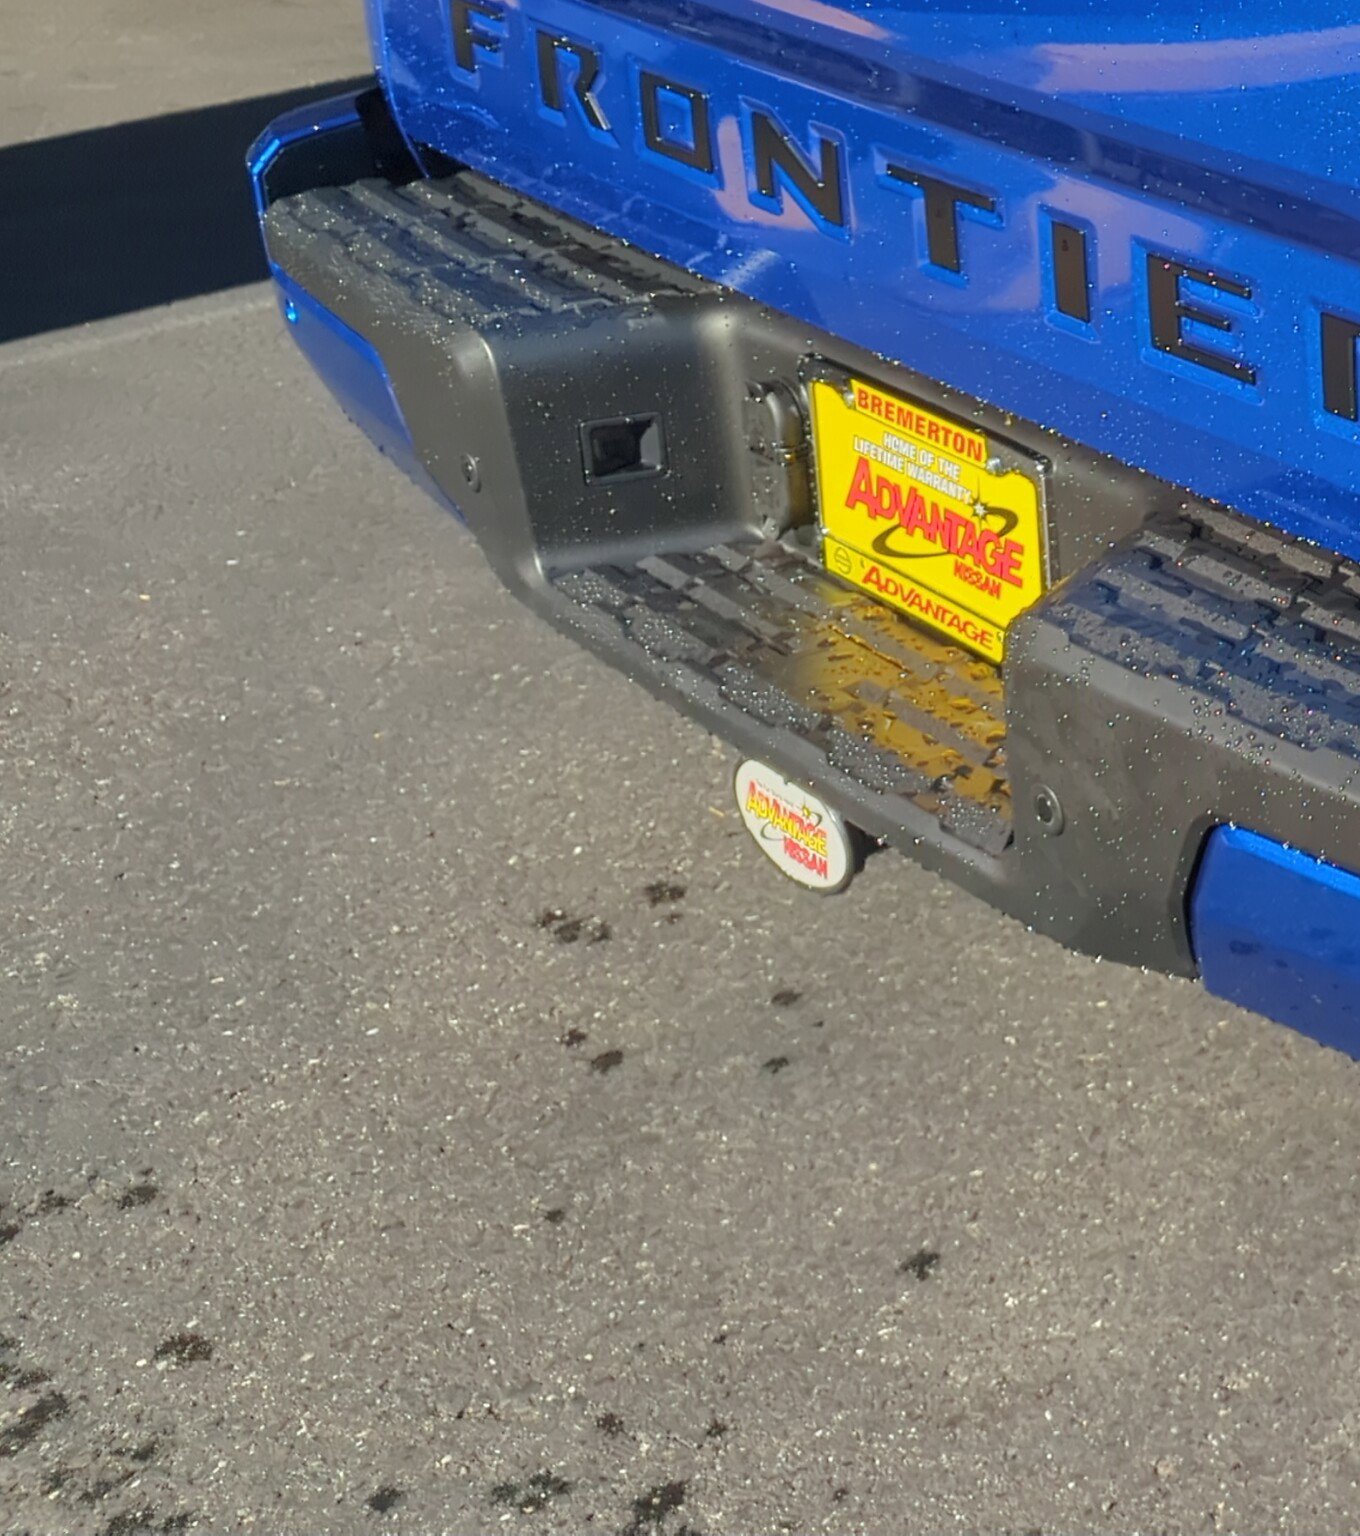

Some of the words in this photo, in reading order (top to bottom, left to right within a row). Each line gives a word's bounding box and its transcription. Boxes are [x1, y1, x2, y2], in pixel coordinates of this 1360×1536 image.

[857, 388, 983, 463] BREMERTON
[883, 432, 916, 460] HOME
[918, 448, 935, 466] OF
[937, 457, 961, 482] THE
[853, 435, 905, 474] LIFETIME
[906, 461, 973, 507] WARRANTY
[845, 456, 1024, 589] ADVANTAGE
[862, 565, 994, 651] ADVANTAGE
[953, 559, 1003, 601] NISSAN
